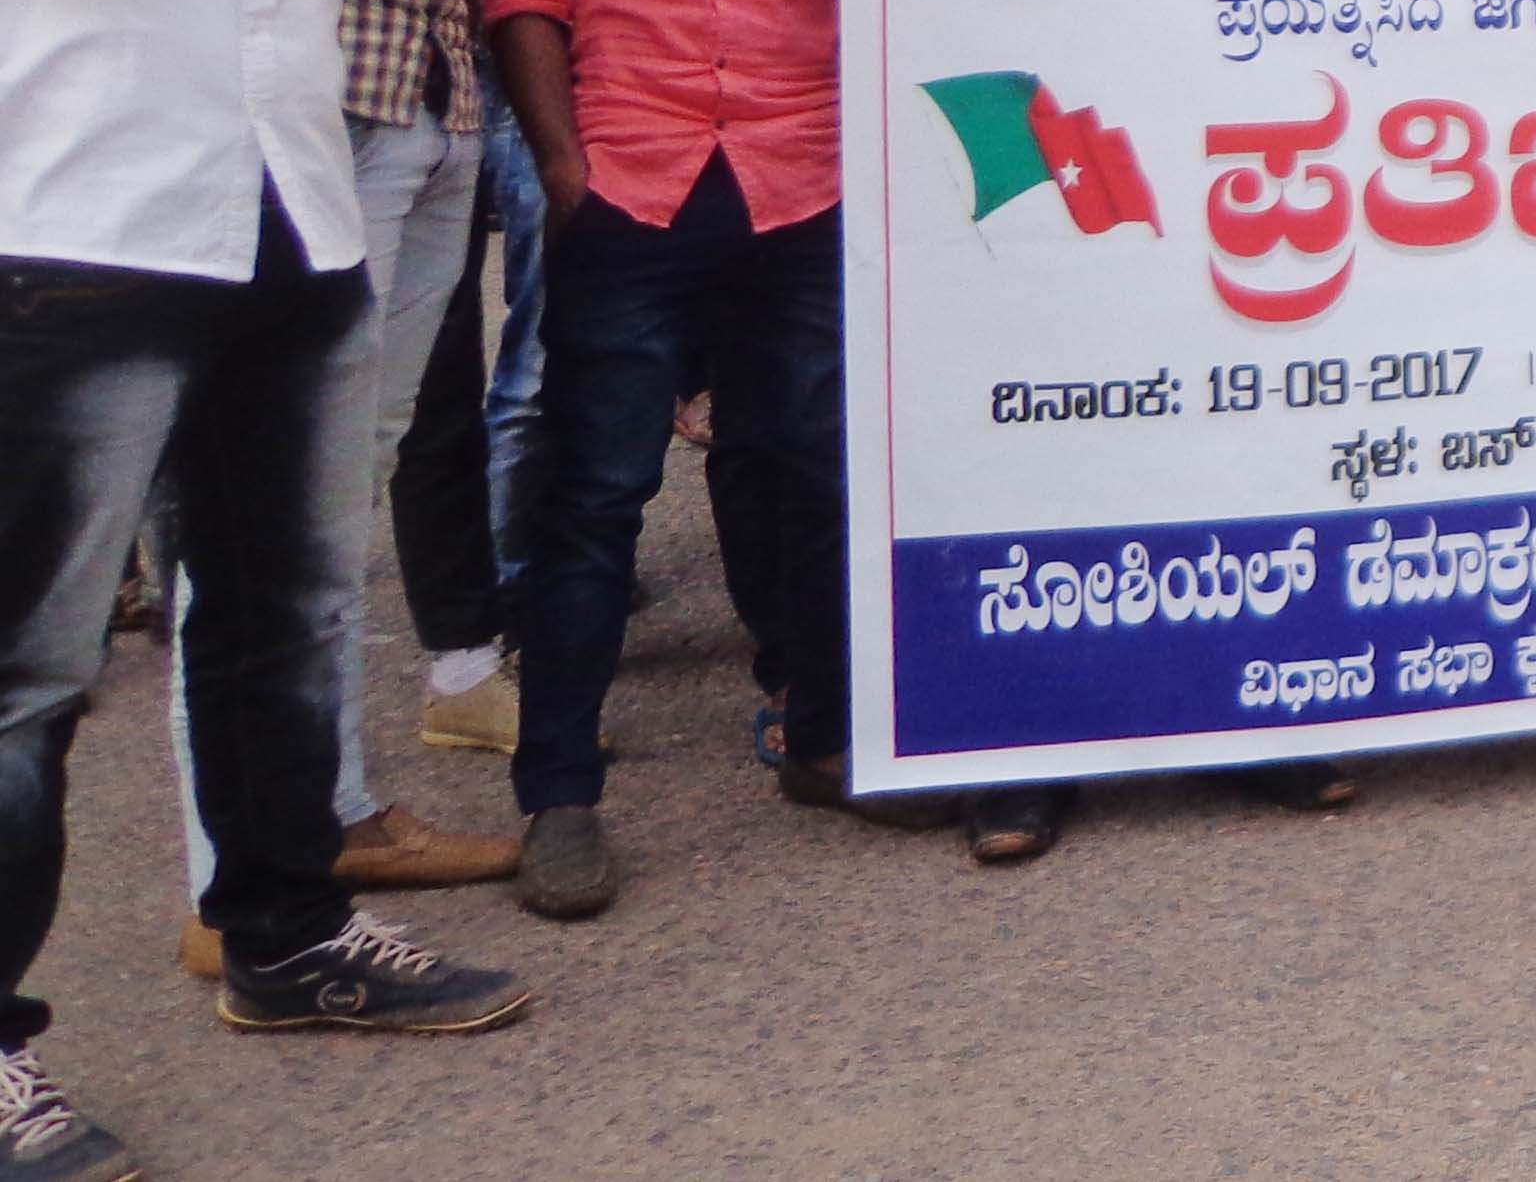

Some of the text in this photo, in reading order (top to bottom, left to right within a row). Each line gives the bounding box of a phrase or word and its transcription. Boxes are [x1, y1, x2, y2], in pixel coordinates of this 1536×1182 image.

[991, 366, 1184, 425] ದಿನಾಂಕ:
[1207, 345, 1484, 414] 19-09-2017
[1330, 424, 1419, 503] ಸ್ಥಳ:
[978, 525, 1318, 636] ಸೋಶಿಯಲ್
[1239, 640, 1376, 713] ವಿಧಾನ
[1398, 633, 1494, 696] ಸಭಾ
